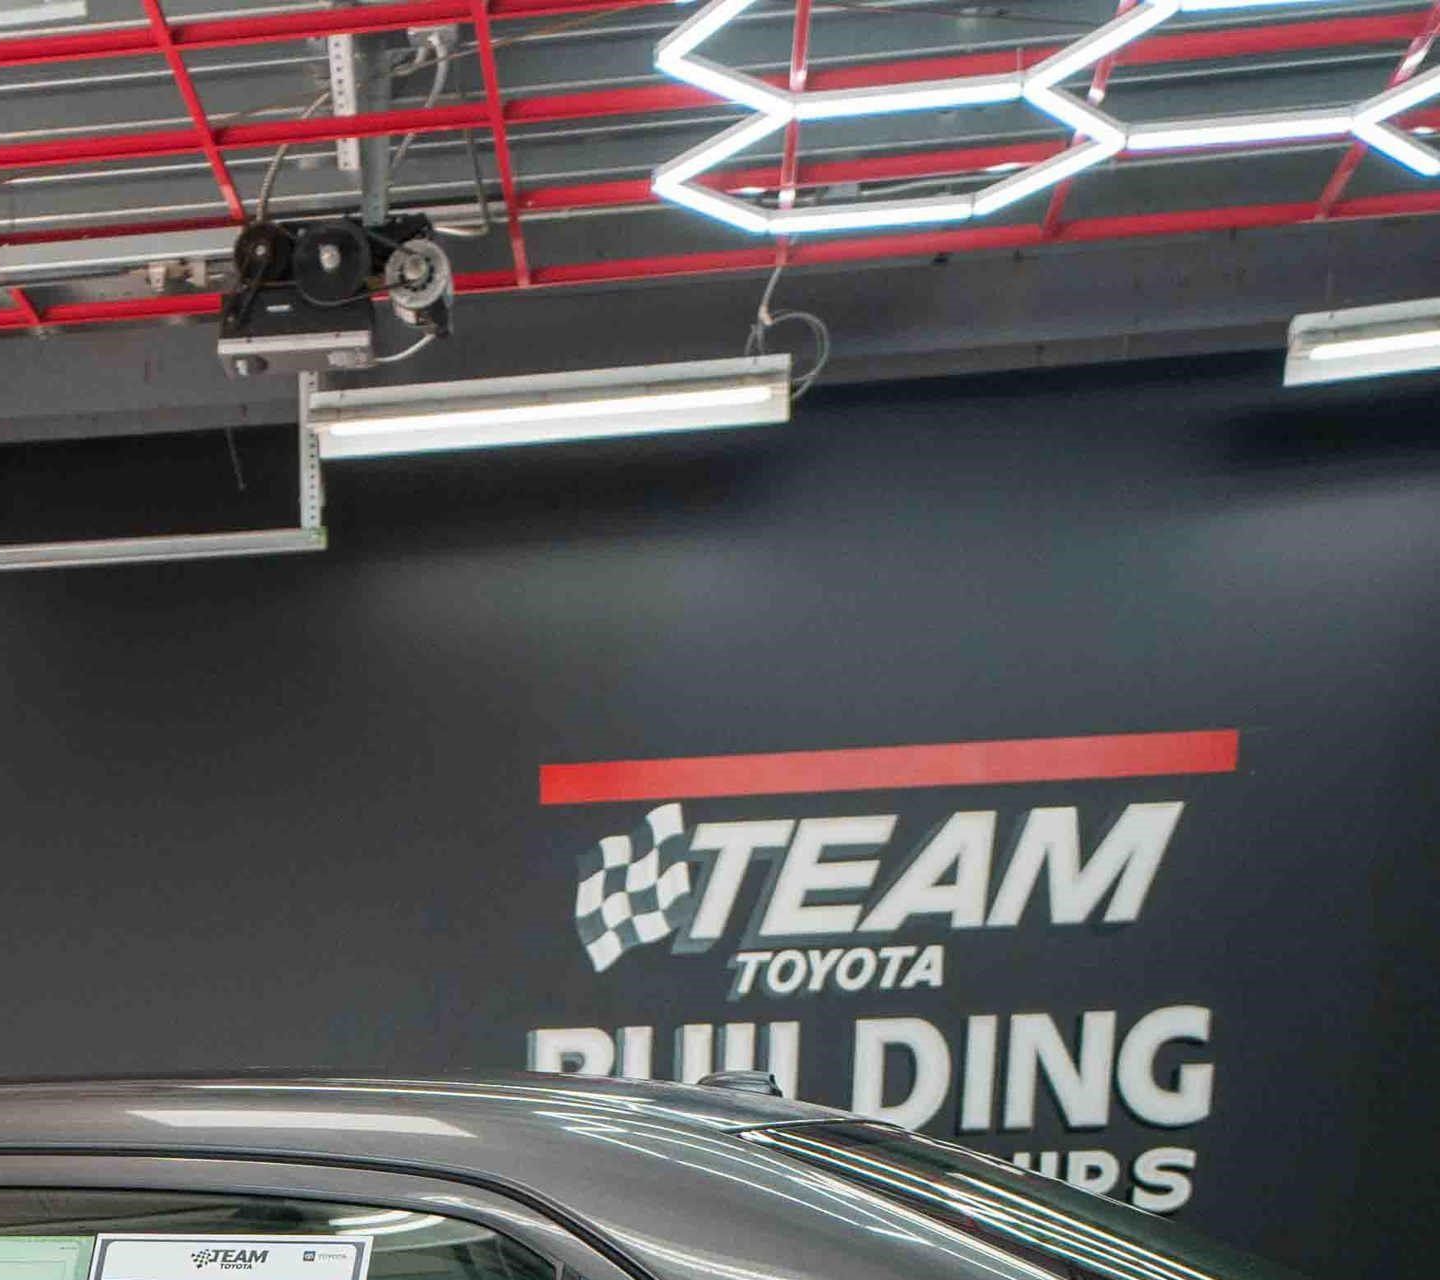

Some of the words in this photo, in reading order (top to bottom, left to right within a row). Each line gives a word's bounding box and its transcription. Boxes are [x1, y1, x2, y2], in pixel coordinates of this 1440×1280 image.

[680, 800, 1186, 946] TEAM
[732, 944, 945, 997] TOYOTA
[209, 1249, 270, 1264] TEAM
